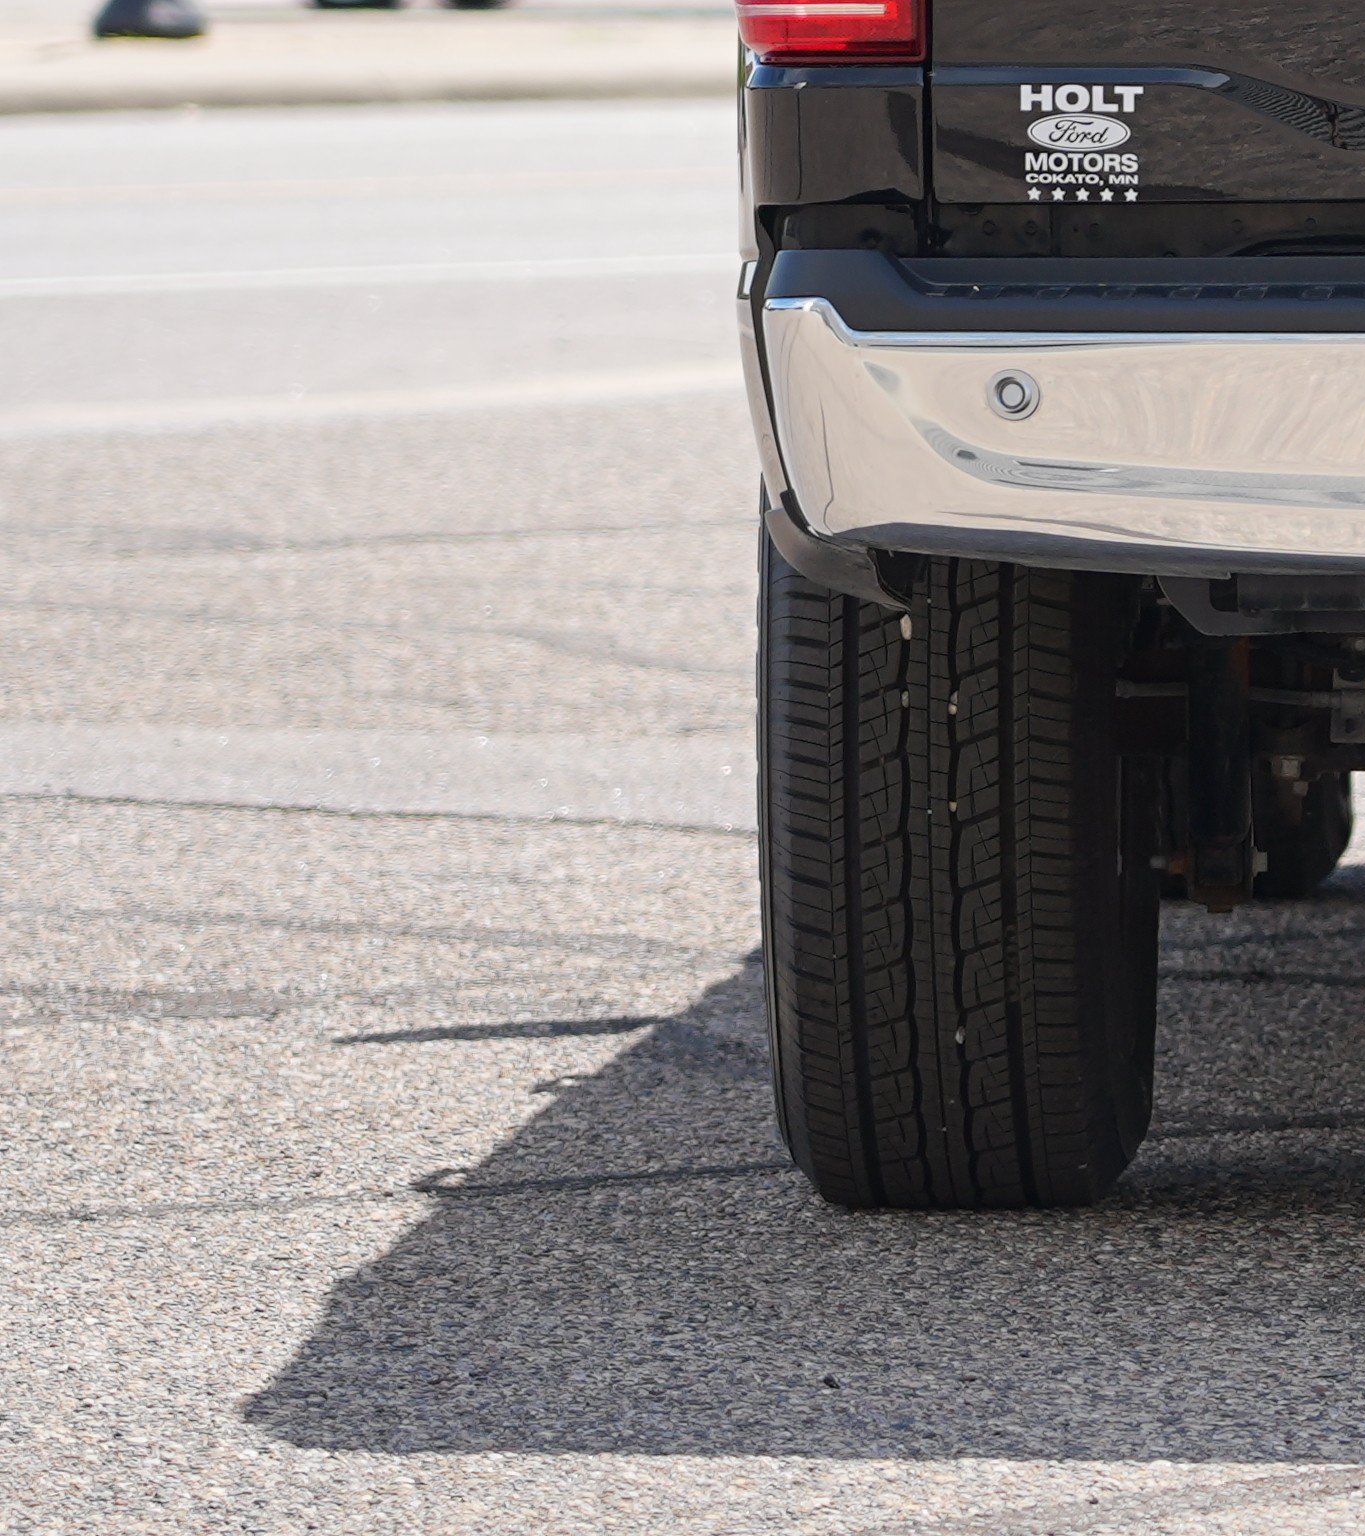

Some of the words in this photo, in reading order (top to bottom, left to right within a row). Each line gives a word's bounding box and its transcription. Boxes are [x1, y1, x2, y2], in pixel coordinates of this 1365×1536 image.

[1020, 84, 1144, 113] HOLT
[1048, 119, 1110, 145] Ford
[1024, 152, 1139, 173] MOTORS
[1025, 173, 1104, 186] COKATO,
[1108, 174, 1139, 185] MN
